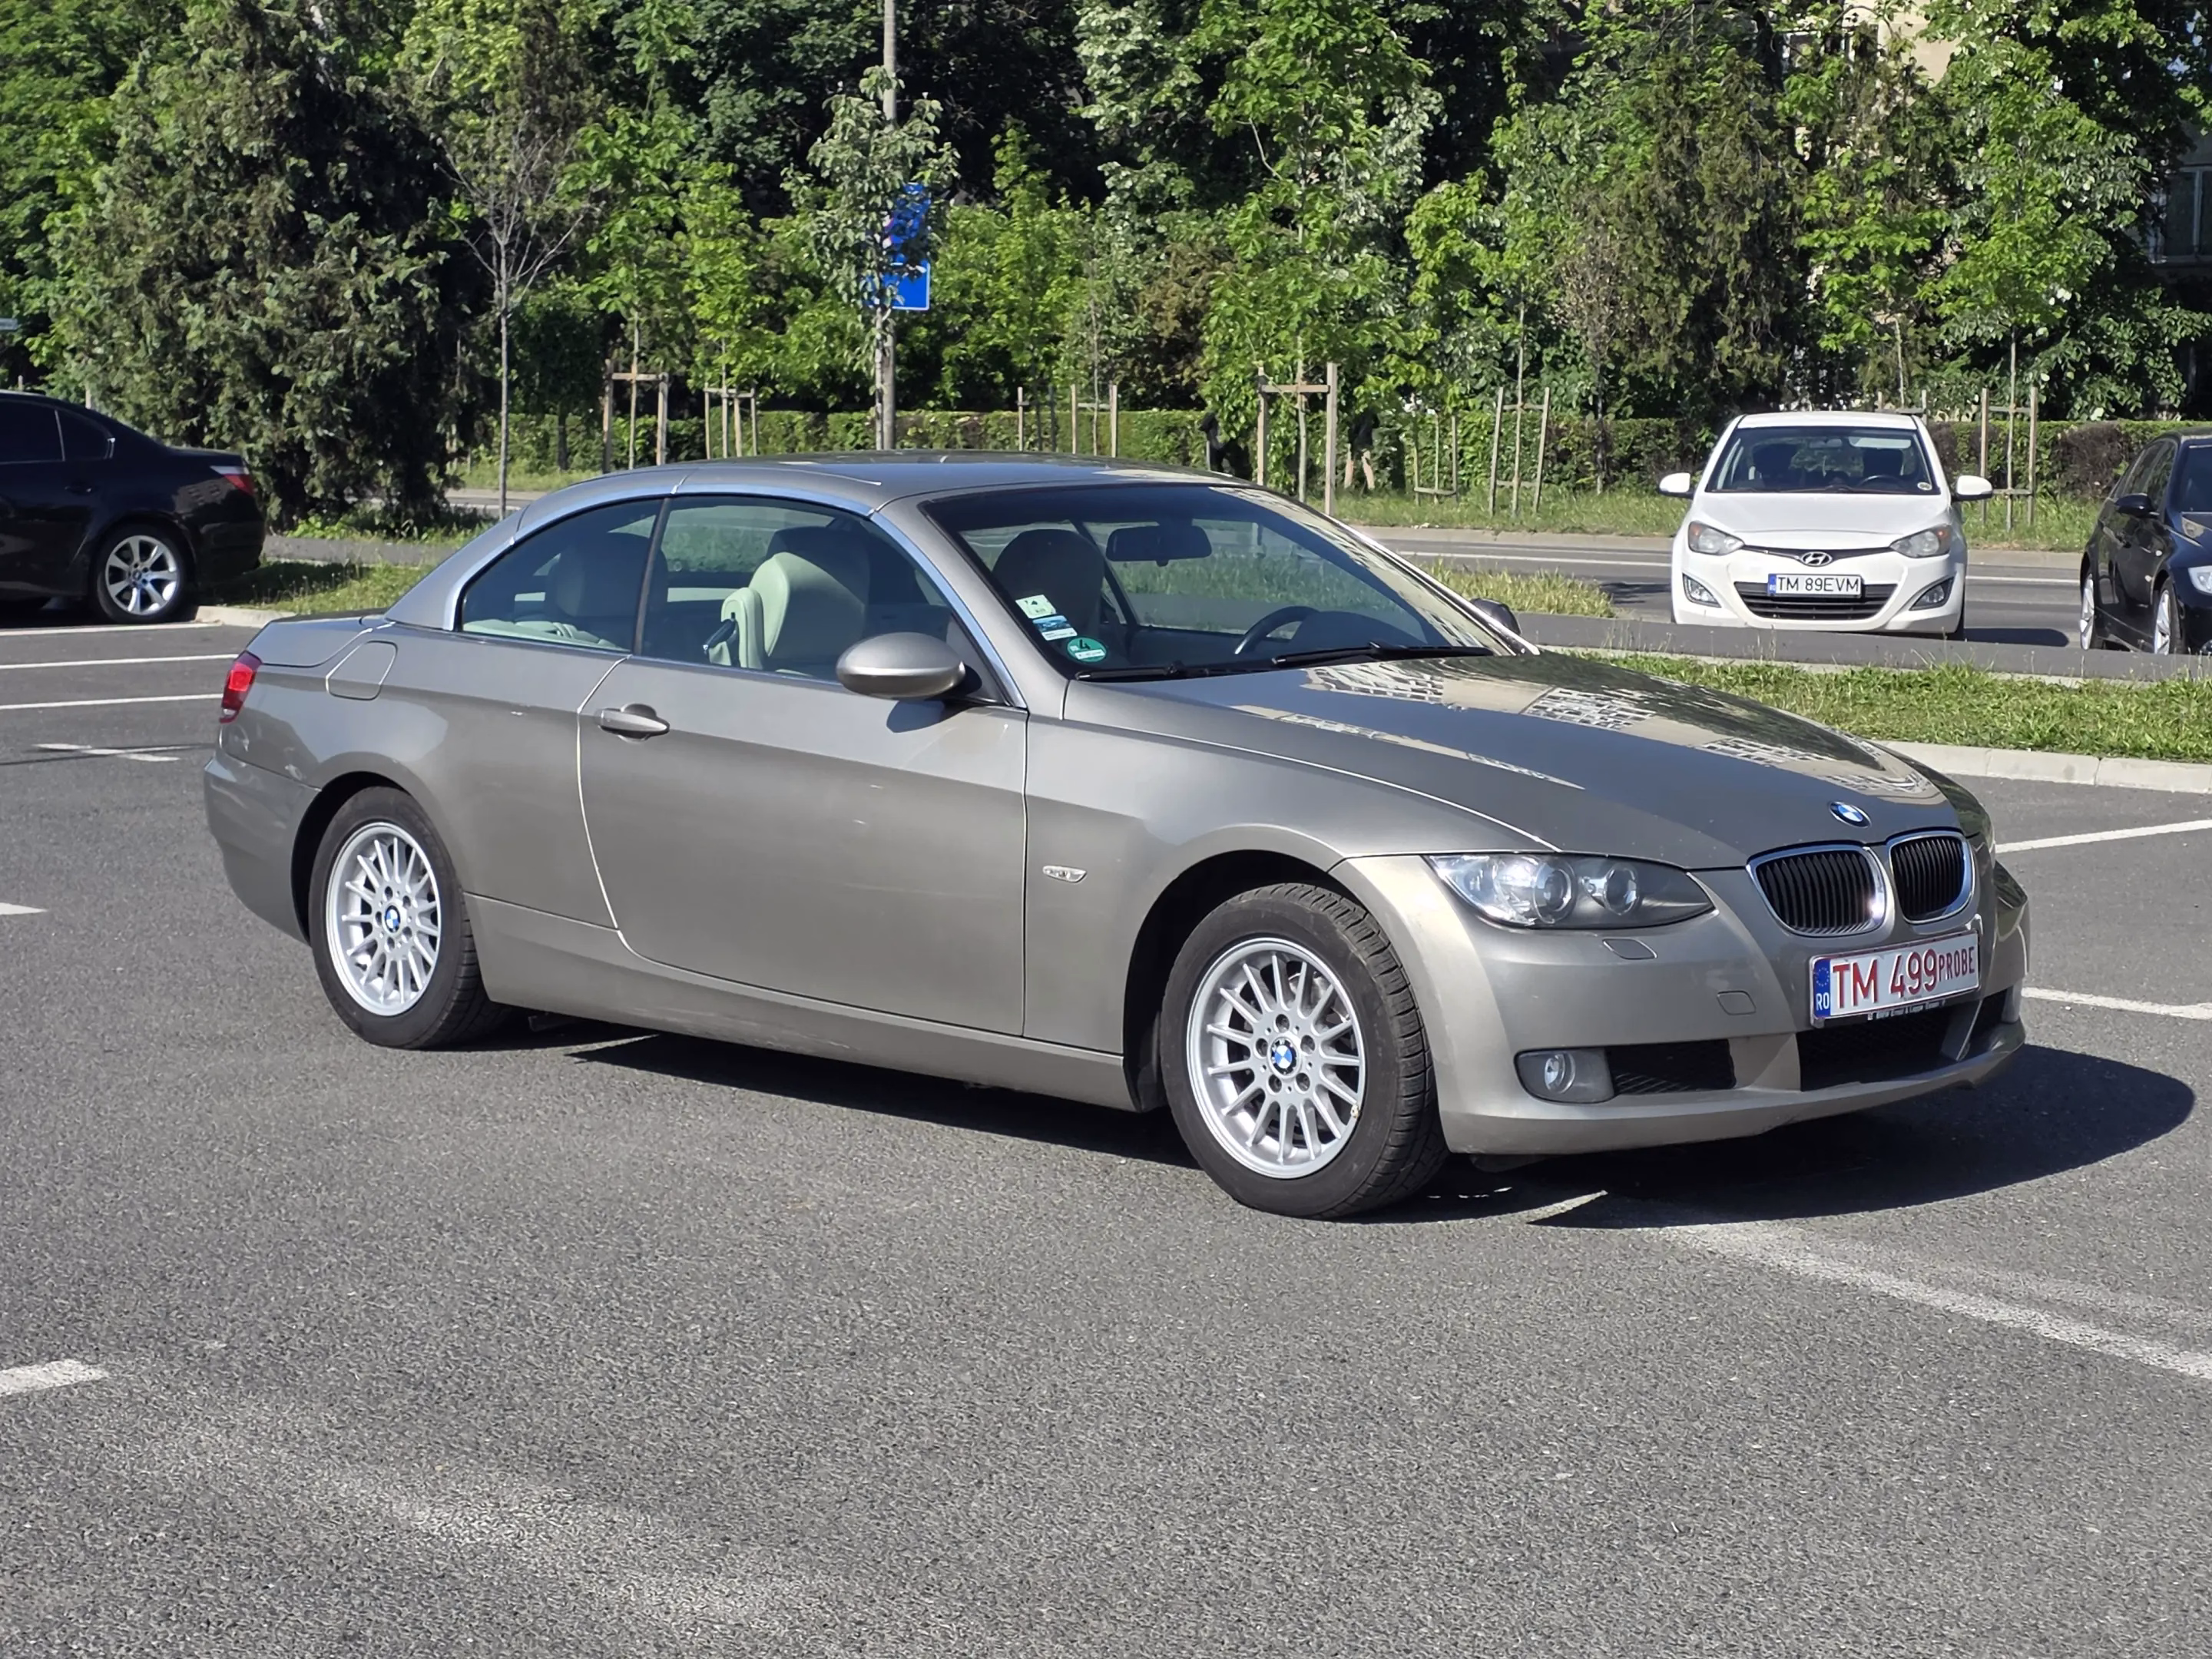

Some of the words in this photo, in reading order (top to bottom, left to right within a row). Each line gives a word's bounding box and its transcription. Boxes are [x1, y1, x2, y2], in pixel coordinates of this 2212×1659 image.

[1777, 577, 1799, 591] TM
[1805, 578, 1859, 592] 89EVM
[1833, 958, 1878, 1009] TM
[1816, 992, 1830, 1011] RO
